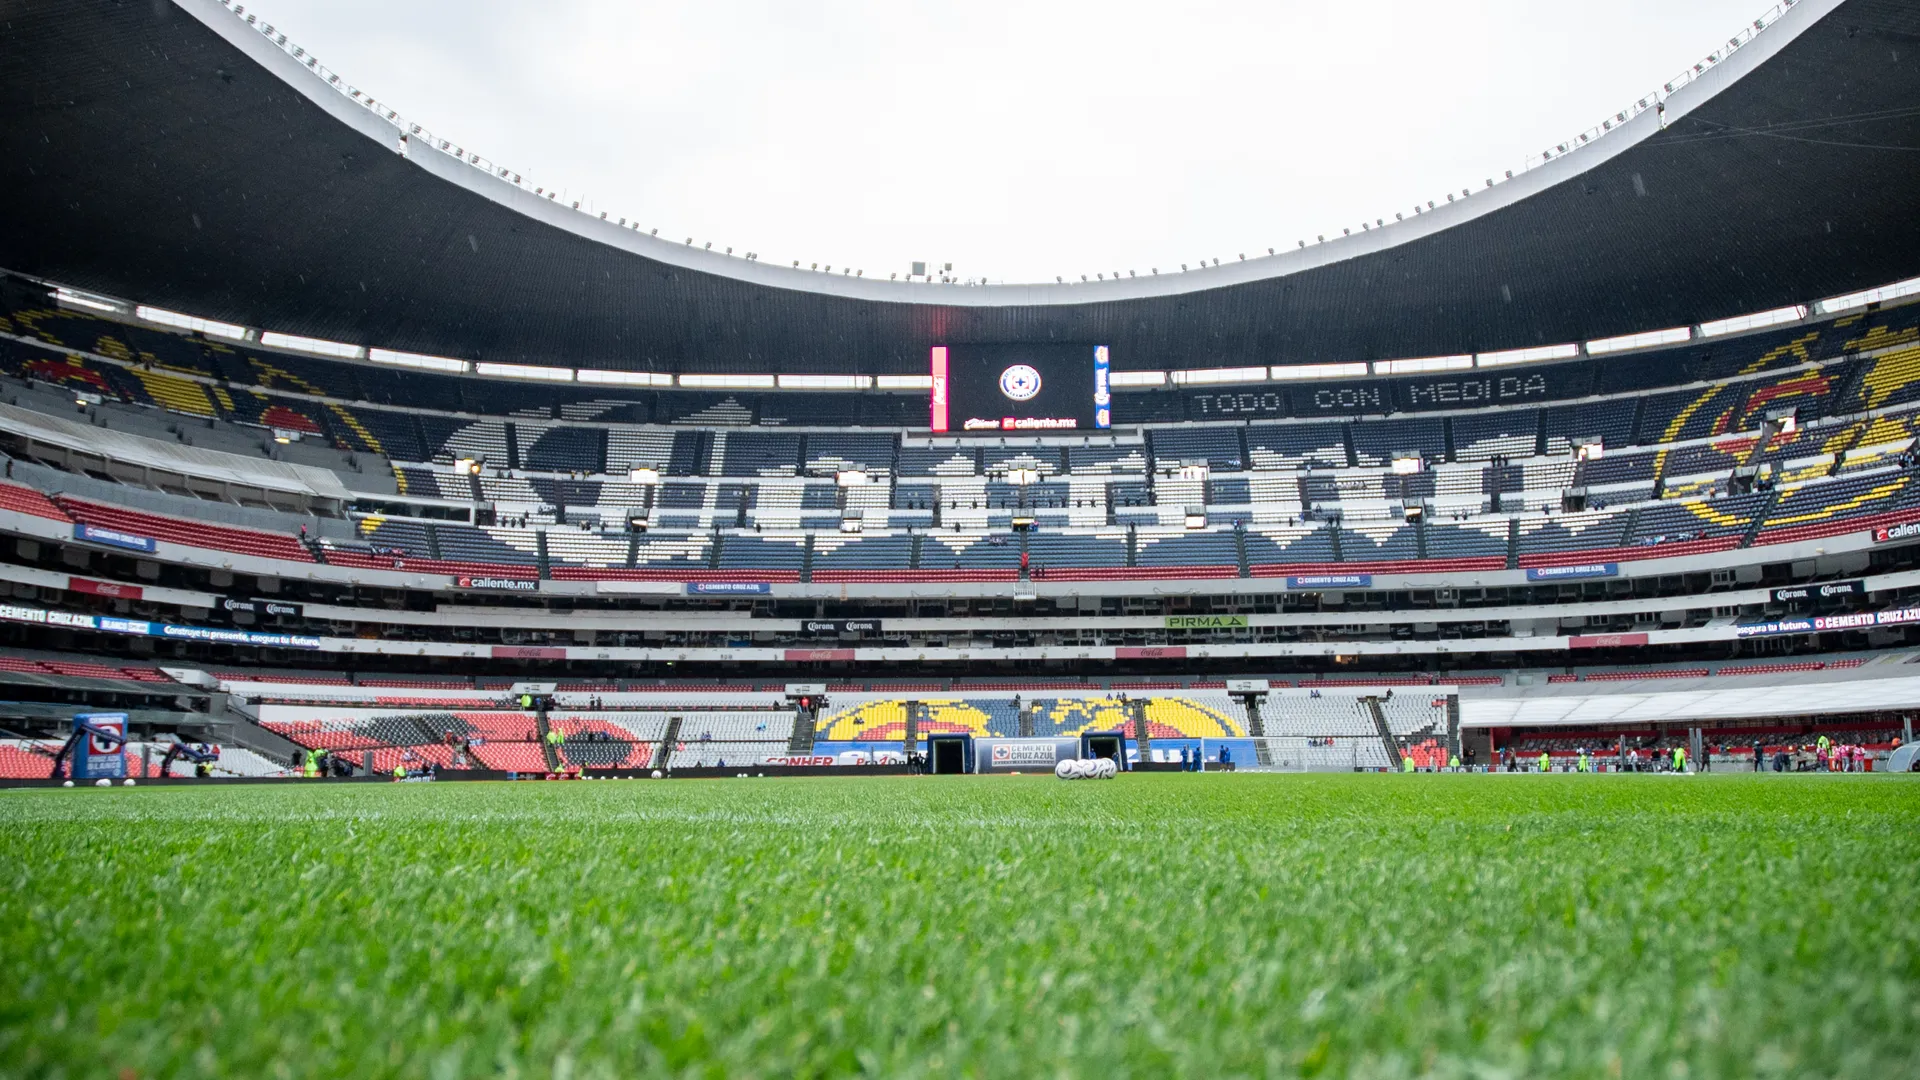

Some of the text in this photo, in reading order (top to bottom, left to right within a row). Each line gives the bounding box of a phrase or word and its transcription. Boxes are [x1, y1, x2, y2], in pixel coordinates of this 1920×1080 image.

[1195, 374, 1545, 412] TODO CON MEDIDA
[1015, 417, 1077, 429] caliente.mx
[471, 577, 534, 589] caliente.mx
[1777, 585, 1853, 600] Corona Corona
[224, 599, 295, 614] Corona Corona
[0, 605, 96, 628] CEMENTO CRUZ AZUL
[1170, 617, 1222, 626] PIRMA
[1825, 614, 1875, 629] CEMENTO
[1877, 610, 1902, 624] CRUZ
[808, 621, 873, 631] Corona Corona
[1767, 623, 1777, 632] tu
[1779, 620, 1811, 631] futuro.
[163, 626, 200, 638] Construye
[201, 629, 210, 637] tu
[211, 631, 250, 642] presente,
[251, 635, 279, 645] asegura
[290, 636, 320, 646] futuro.
[1140, 648, 1163, 656] Coca-Cola
[1011, 752, 1033, 760] CRUZ
